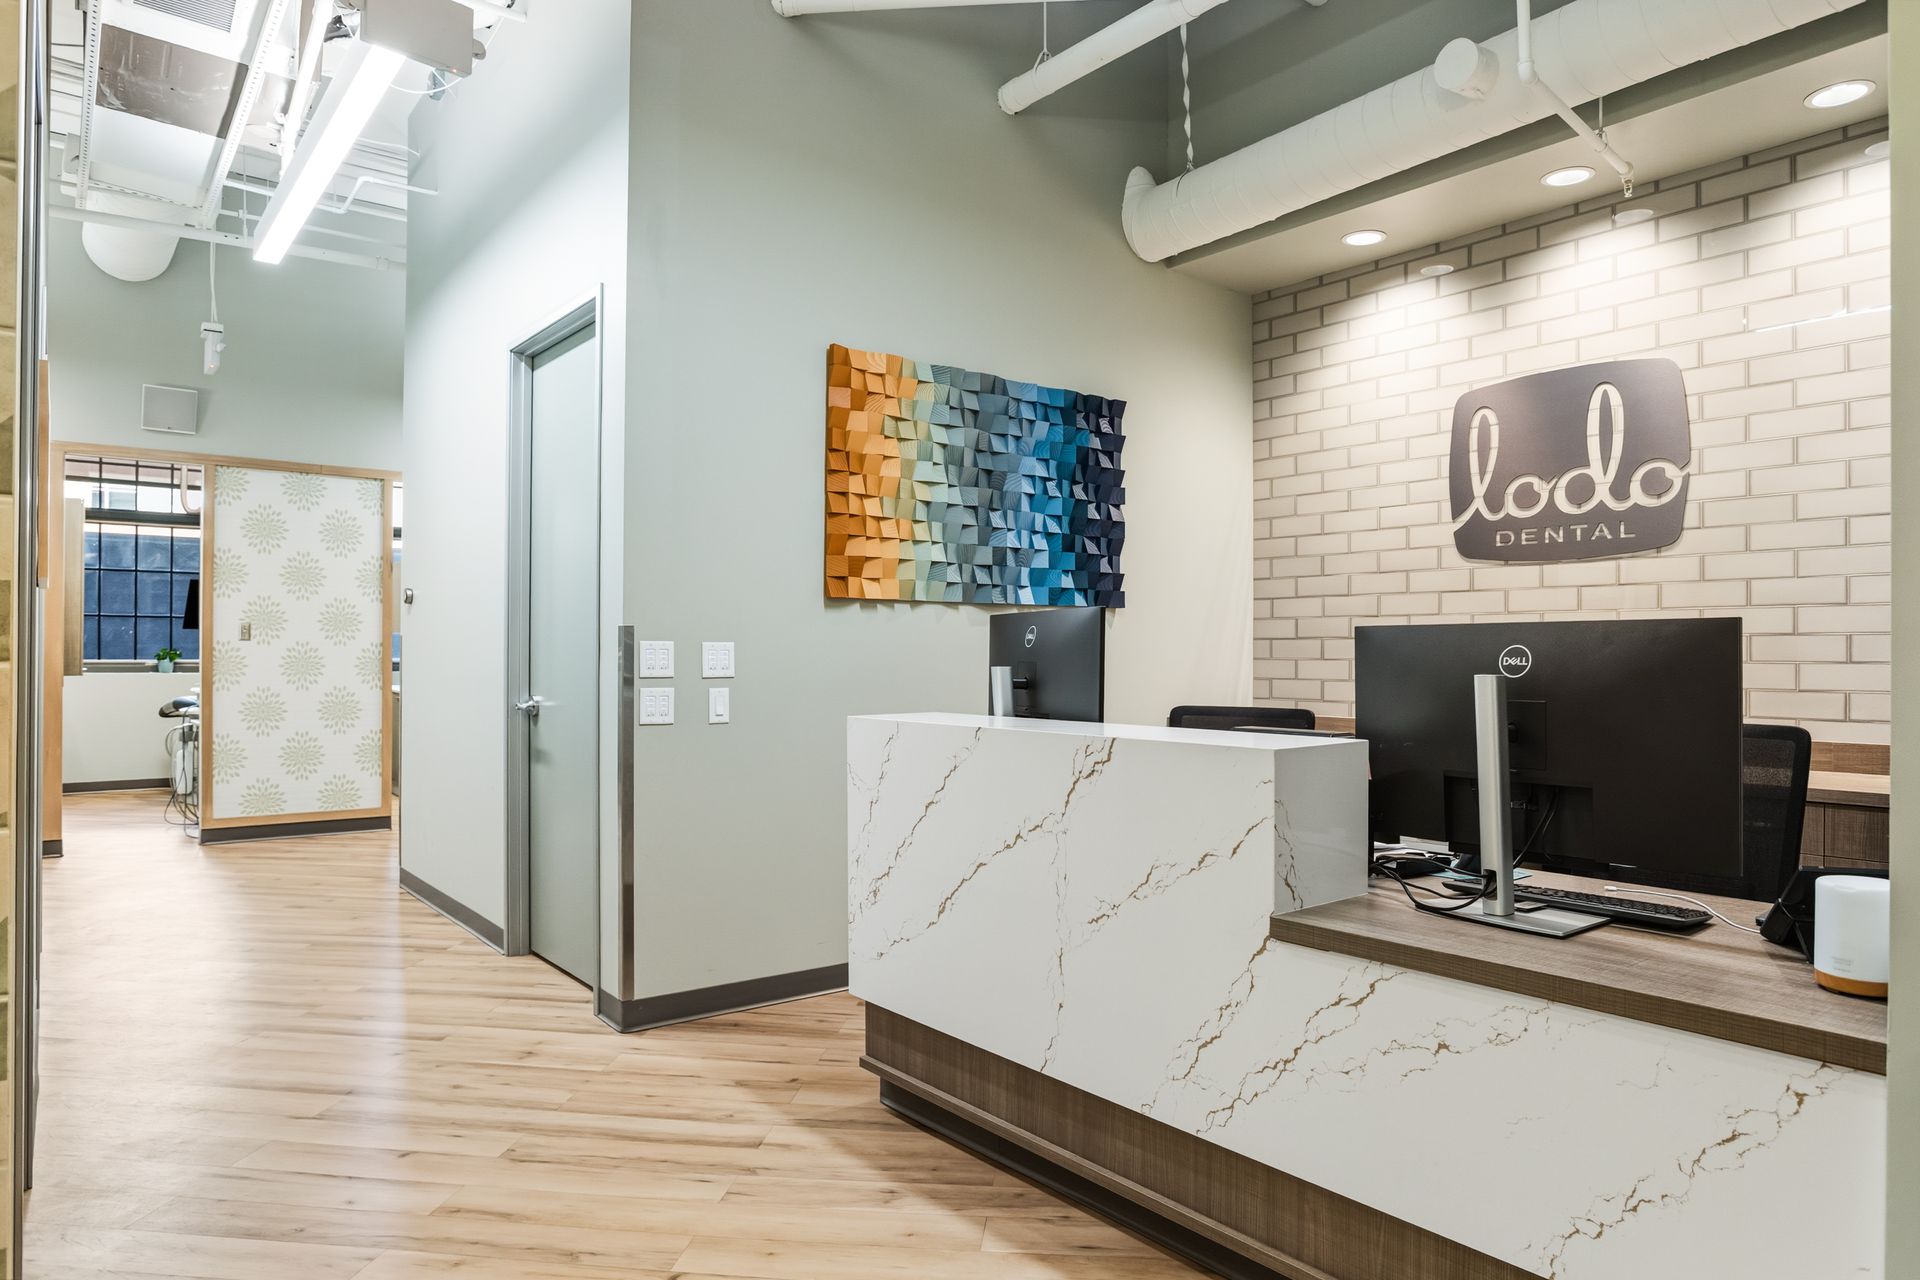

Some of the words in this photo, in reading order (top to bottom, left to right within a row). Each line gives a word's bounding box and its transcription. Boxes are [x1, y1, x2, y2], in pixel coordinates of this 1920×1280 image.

[1454, 382, 1689, 529] lodo
[1495, 521, 1636, 547] DENTAL
[1503, 656, 1528, 666] DELL
